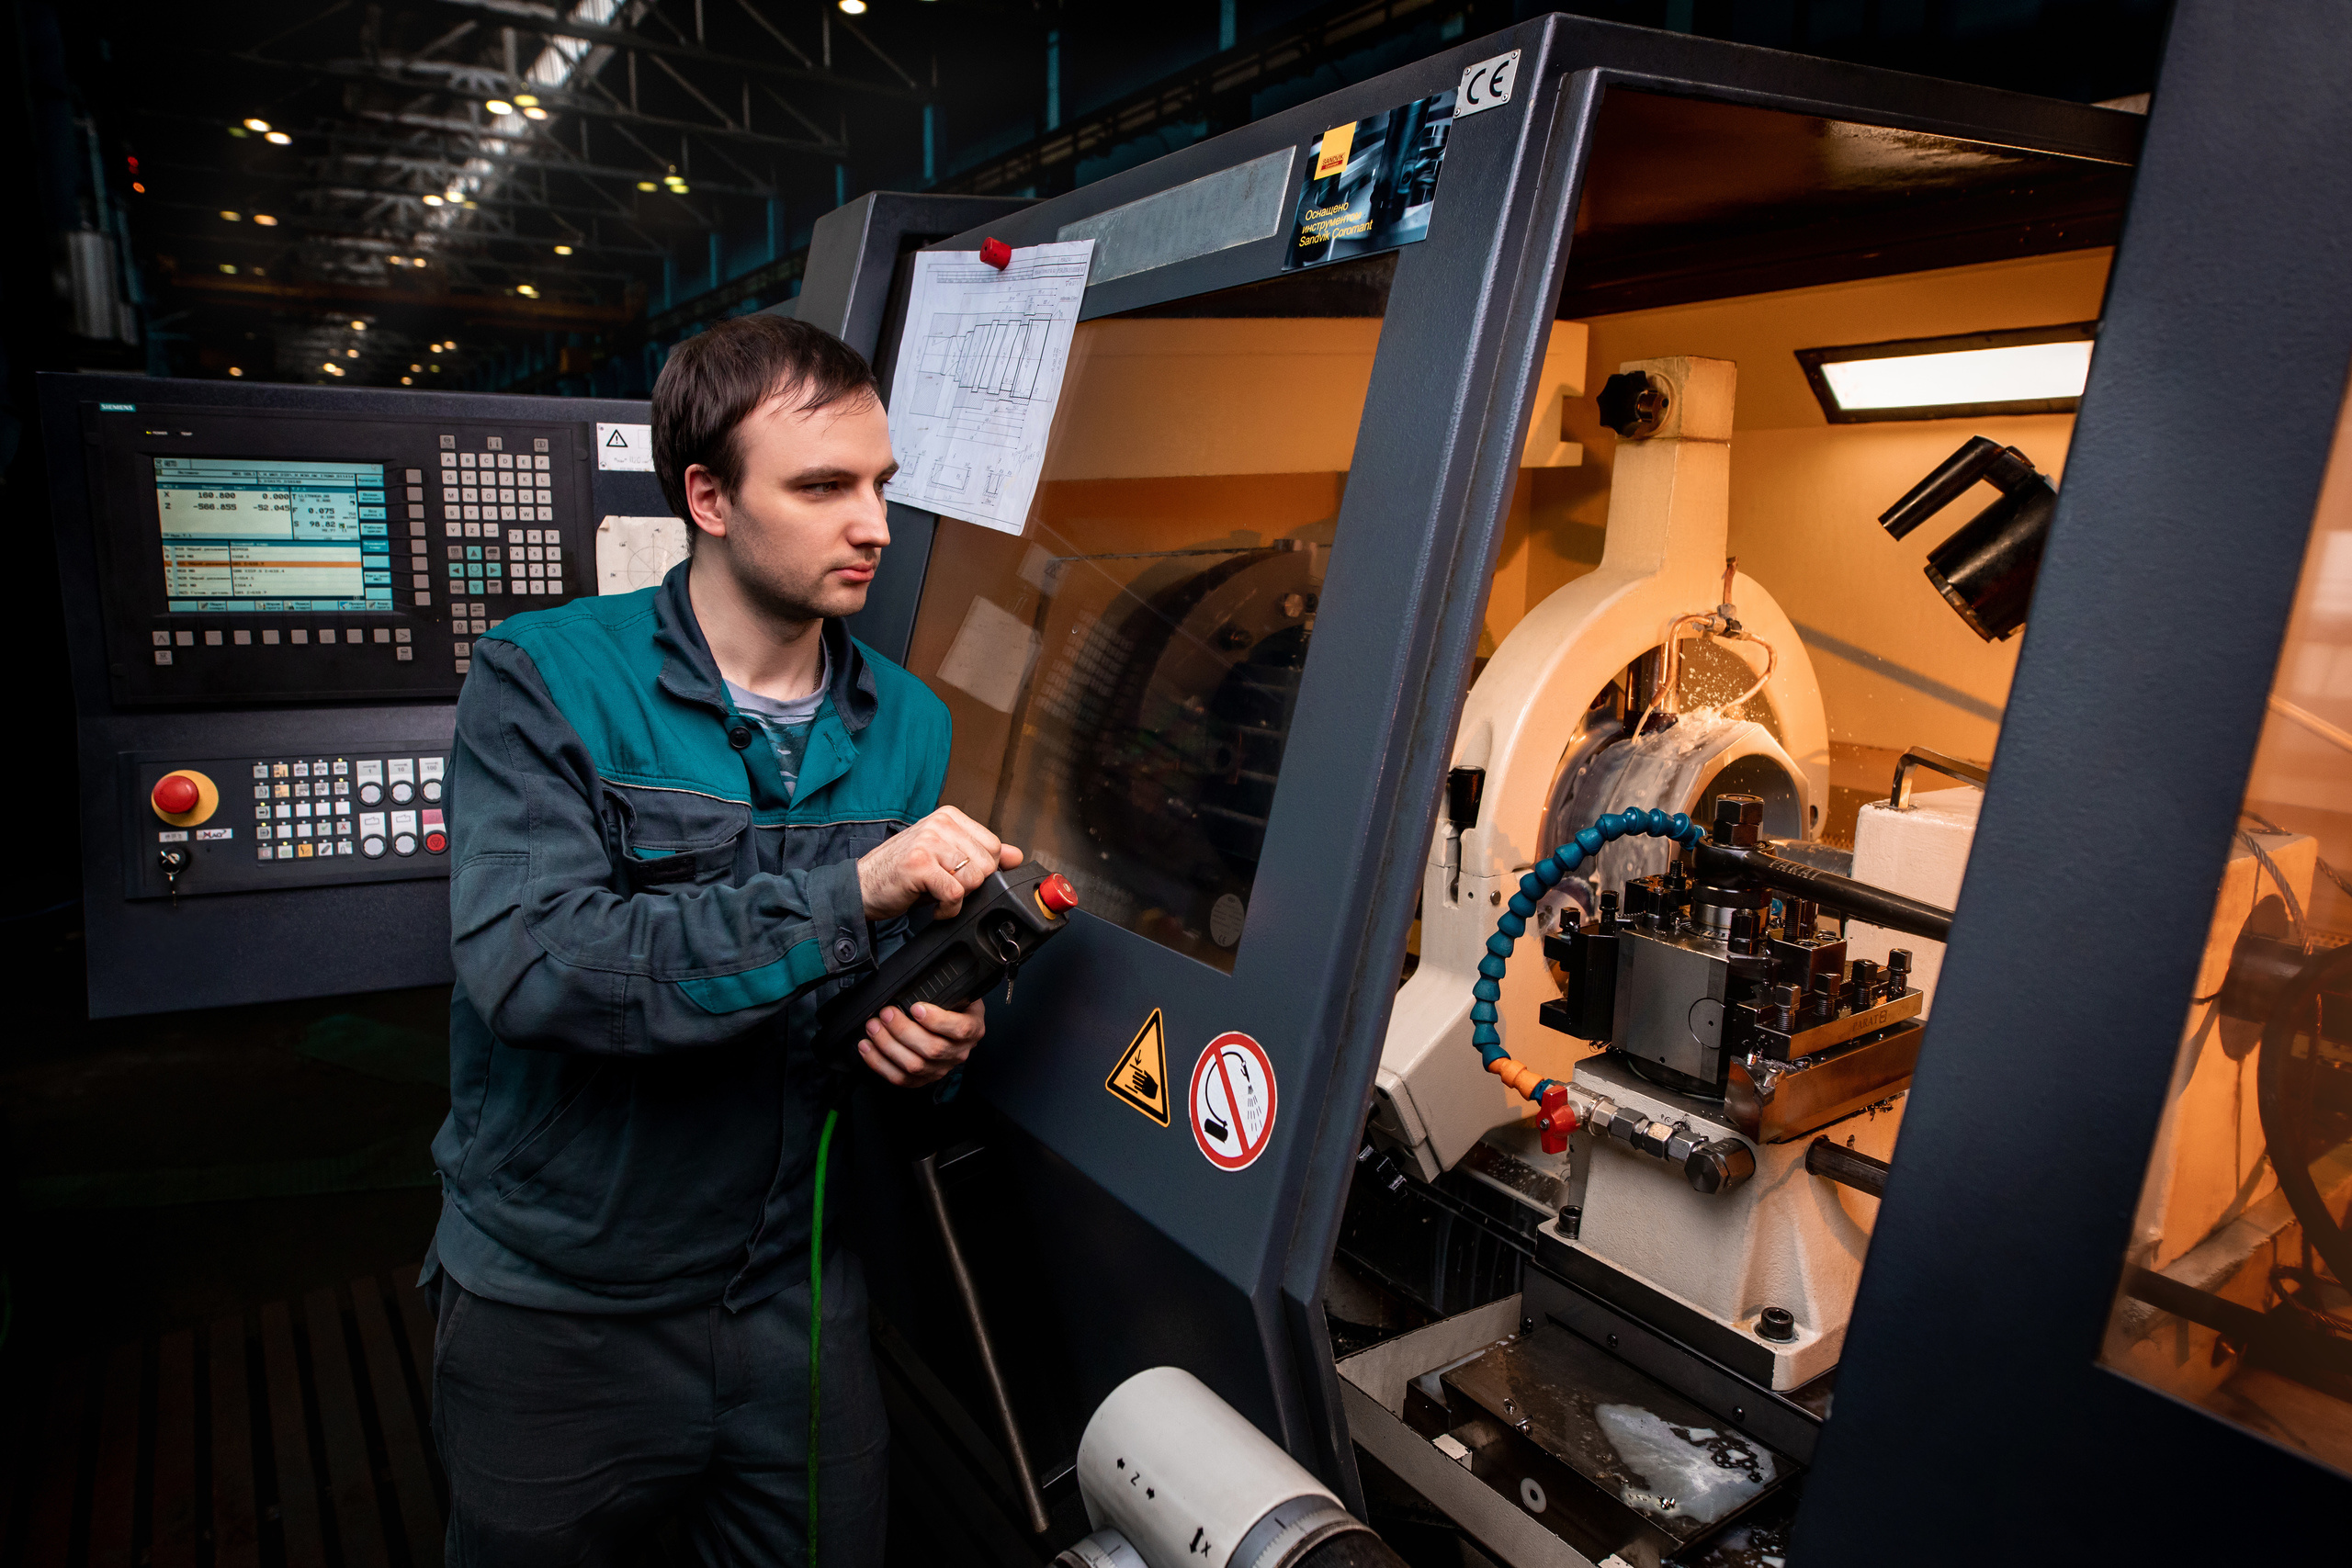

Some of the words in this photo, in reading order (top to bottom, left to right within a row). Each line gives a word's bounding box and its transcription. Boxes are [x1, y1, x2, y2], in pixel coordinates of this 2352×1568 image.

[1466, 60, 1510, 105] CE
[1322, 152, 1345, 165] SANDVIK
[1305, 202, 1349, 220] Оснащено
[1302, 211, 1362, 233] инструментом
[1298, 231, 1330, 247] Sandvik
[1331, 220, 1374, 239] Coromant
[1852, 1014, 1879, 1032] PARAT
